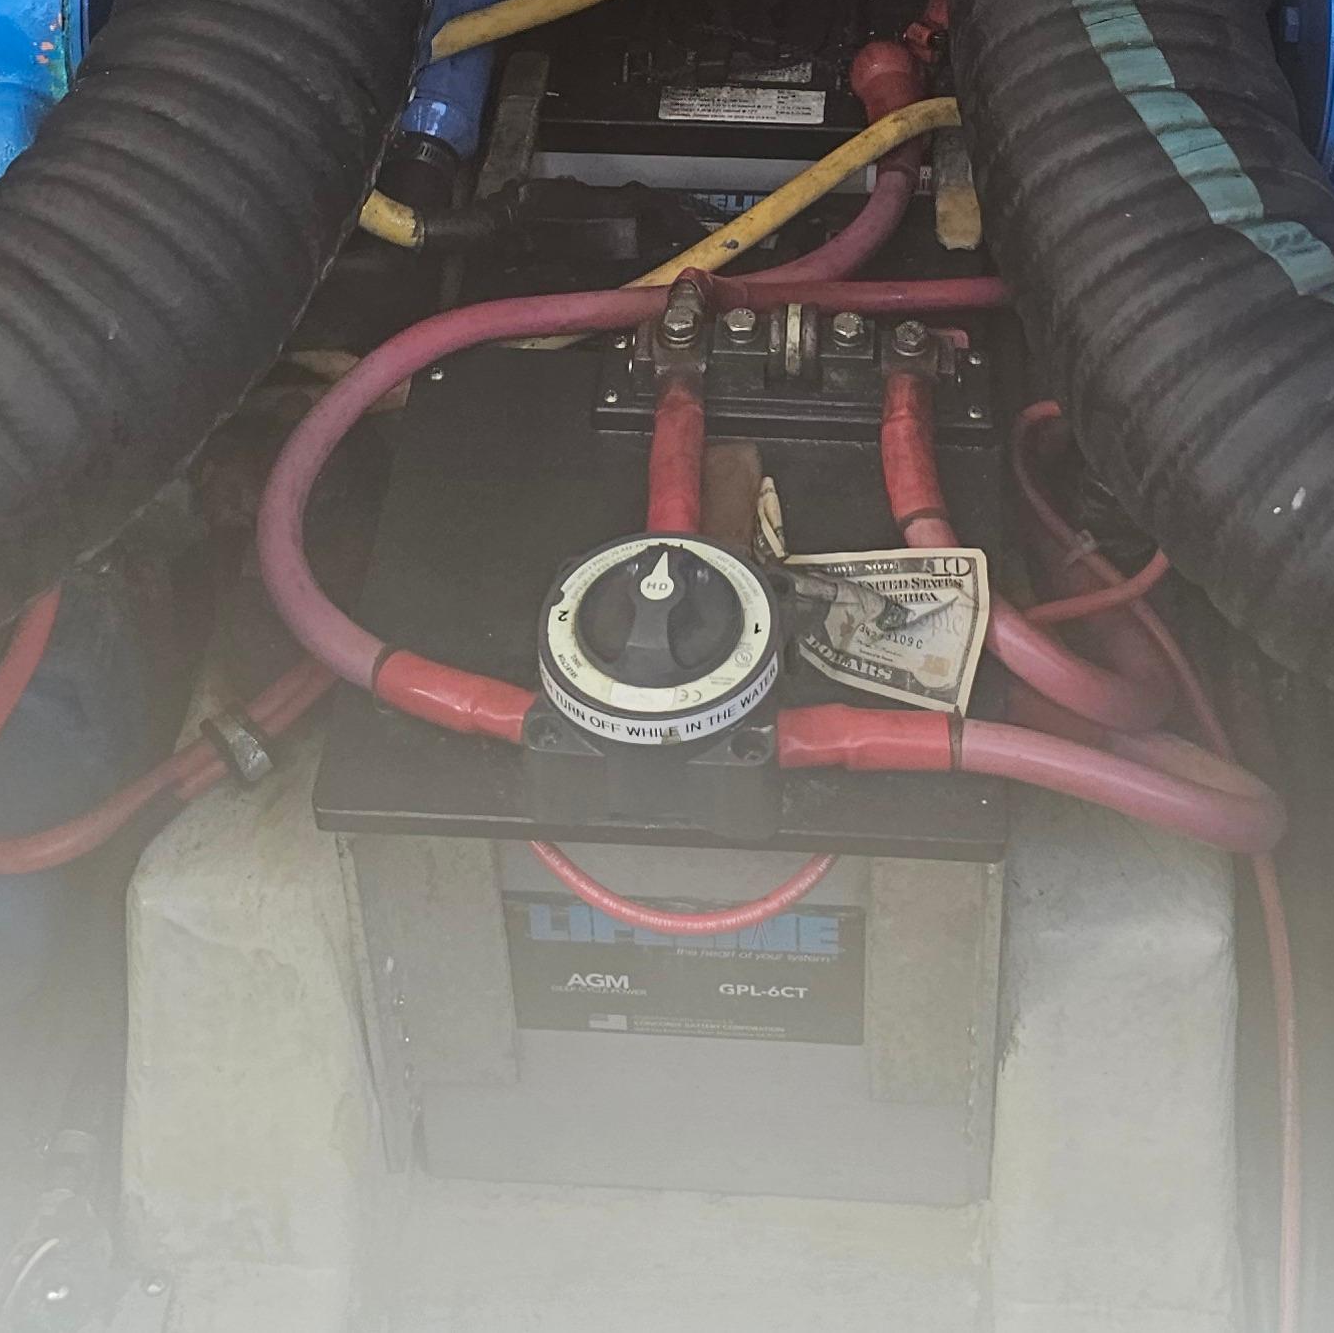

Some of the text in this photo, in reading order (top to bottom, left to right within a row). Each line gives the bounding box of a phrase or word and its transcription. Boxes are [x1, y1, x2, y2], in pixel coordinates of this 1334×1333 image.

[932, 557, 972, 577] 10
[910, 577, 964, 590] STATES
[558, 610, 569, 622] 2
[753, 622, 762, 635] 1
[589, 716, 621, 733] OFF
[685, 721, 702, 734] IN
[707, 703, 737, 727] THE
[740, 664, 777, 709] WATER
[567, 973, 629, 989] AGM
[719, 983, 809, 999] GPL-6CT
